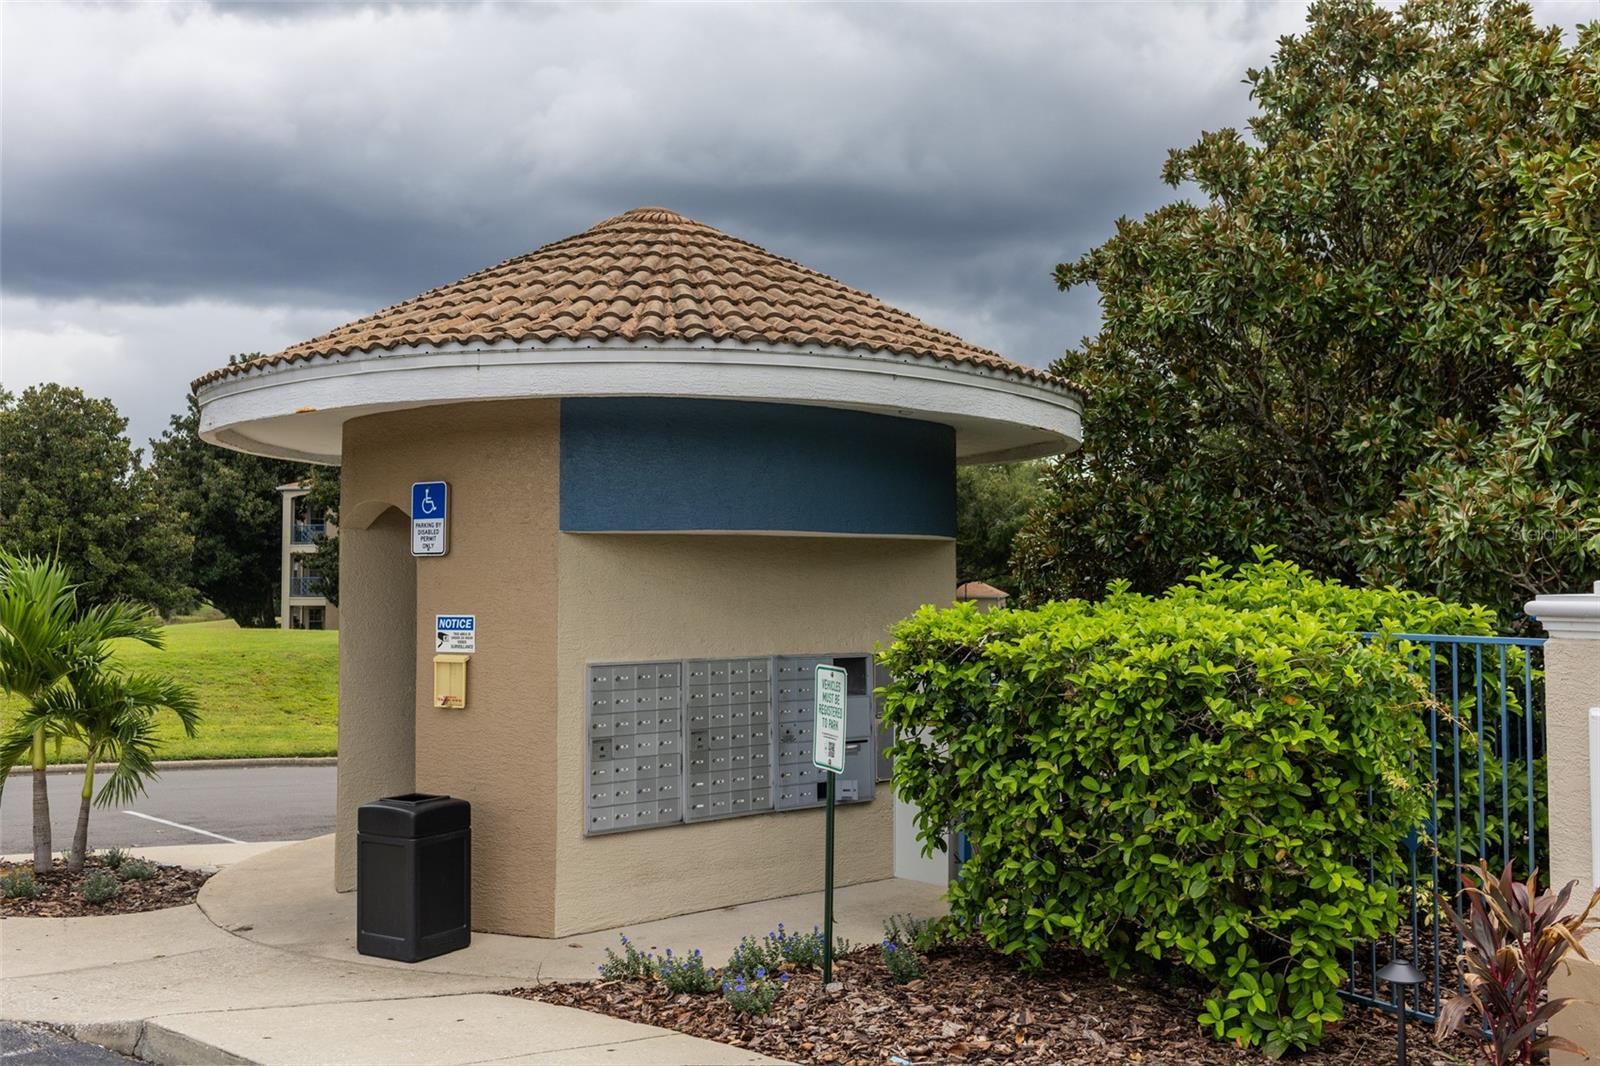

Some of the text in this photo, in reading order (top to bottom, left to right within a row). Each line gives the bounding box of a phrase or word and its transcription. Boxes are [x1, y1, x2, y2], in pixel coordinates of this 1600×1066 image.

[438, 618, 472, 628] NOTICE
[822, 679, 841, 692] VEHICLES
[822, 692, 840, 705] MUST BE
[819, 704, 842, 719] REGISTERED
[822, 717, 839, 730] TO PARK
